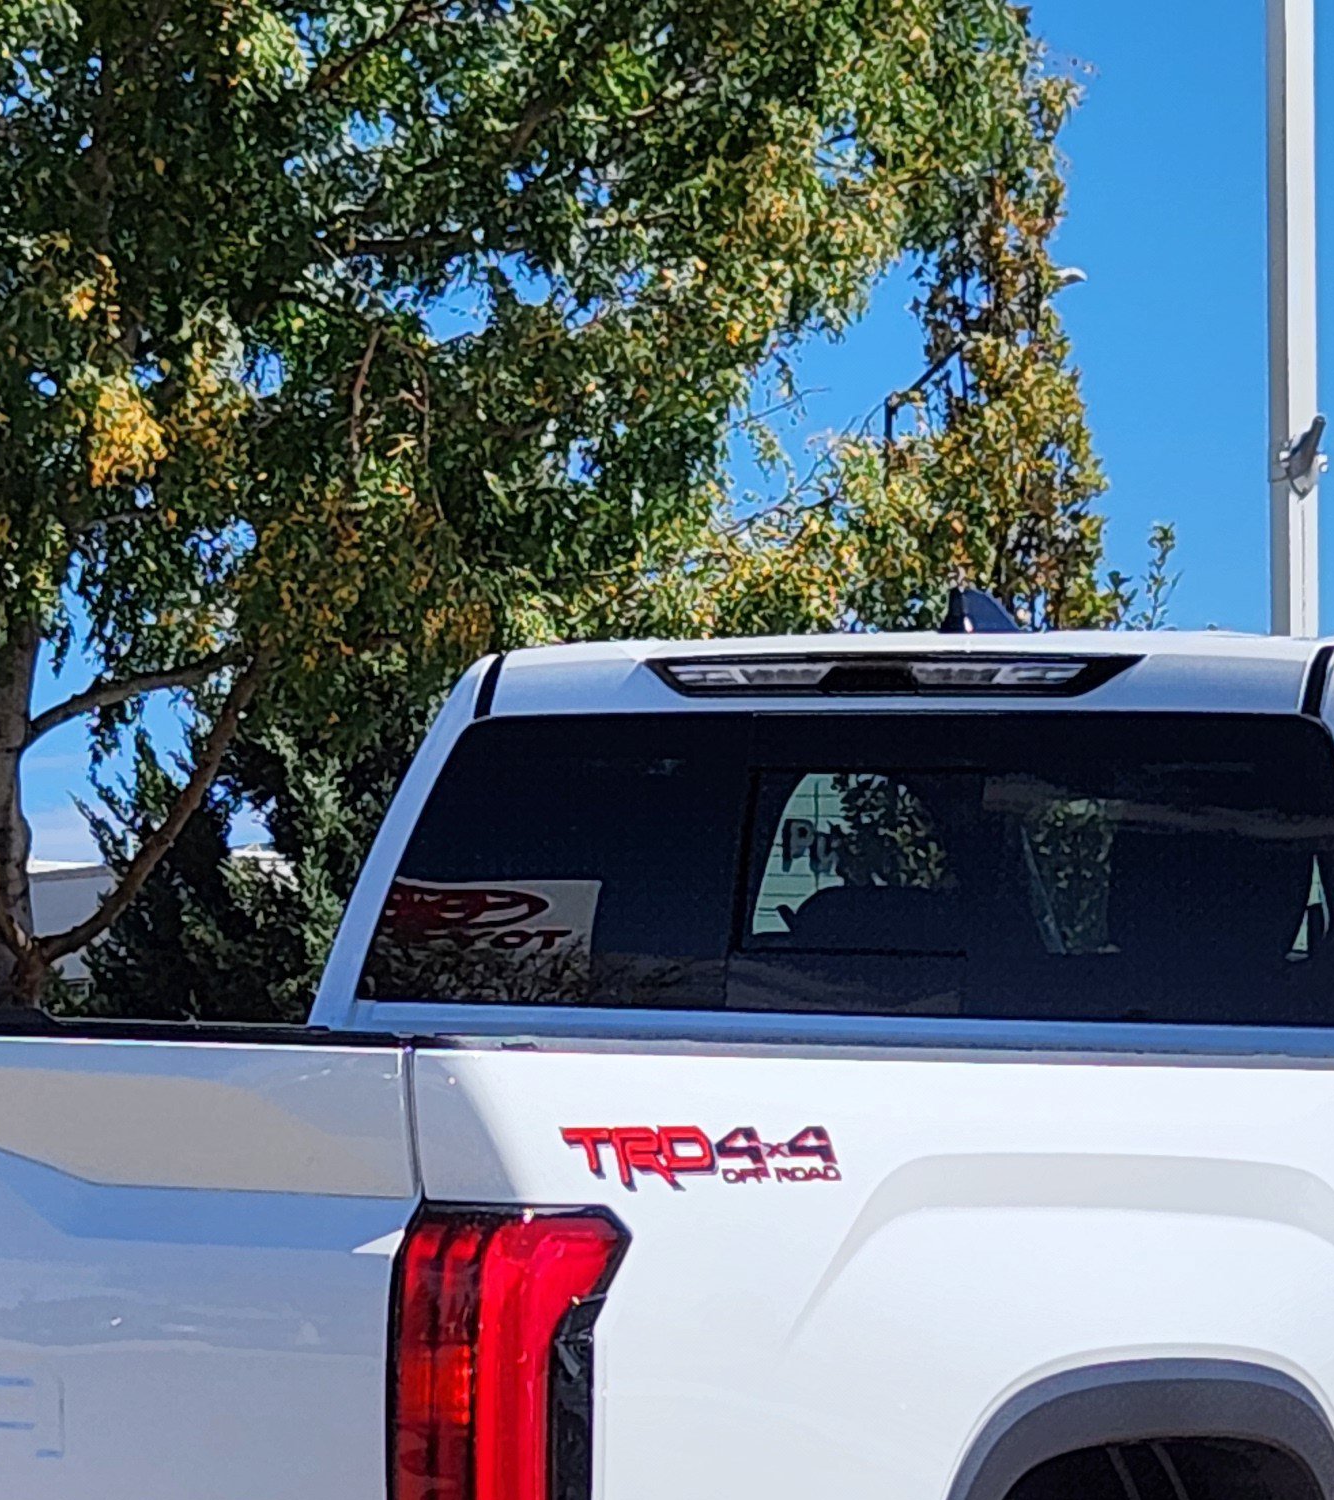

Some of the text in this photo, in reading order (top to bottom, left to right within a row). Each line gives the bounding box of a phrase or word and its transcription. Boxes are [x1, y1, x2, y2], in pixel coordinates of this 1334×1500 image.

[558, 1125, 718, 1192] TRD
[721, 1165, 842, 1184] OFF ROAD
